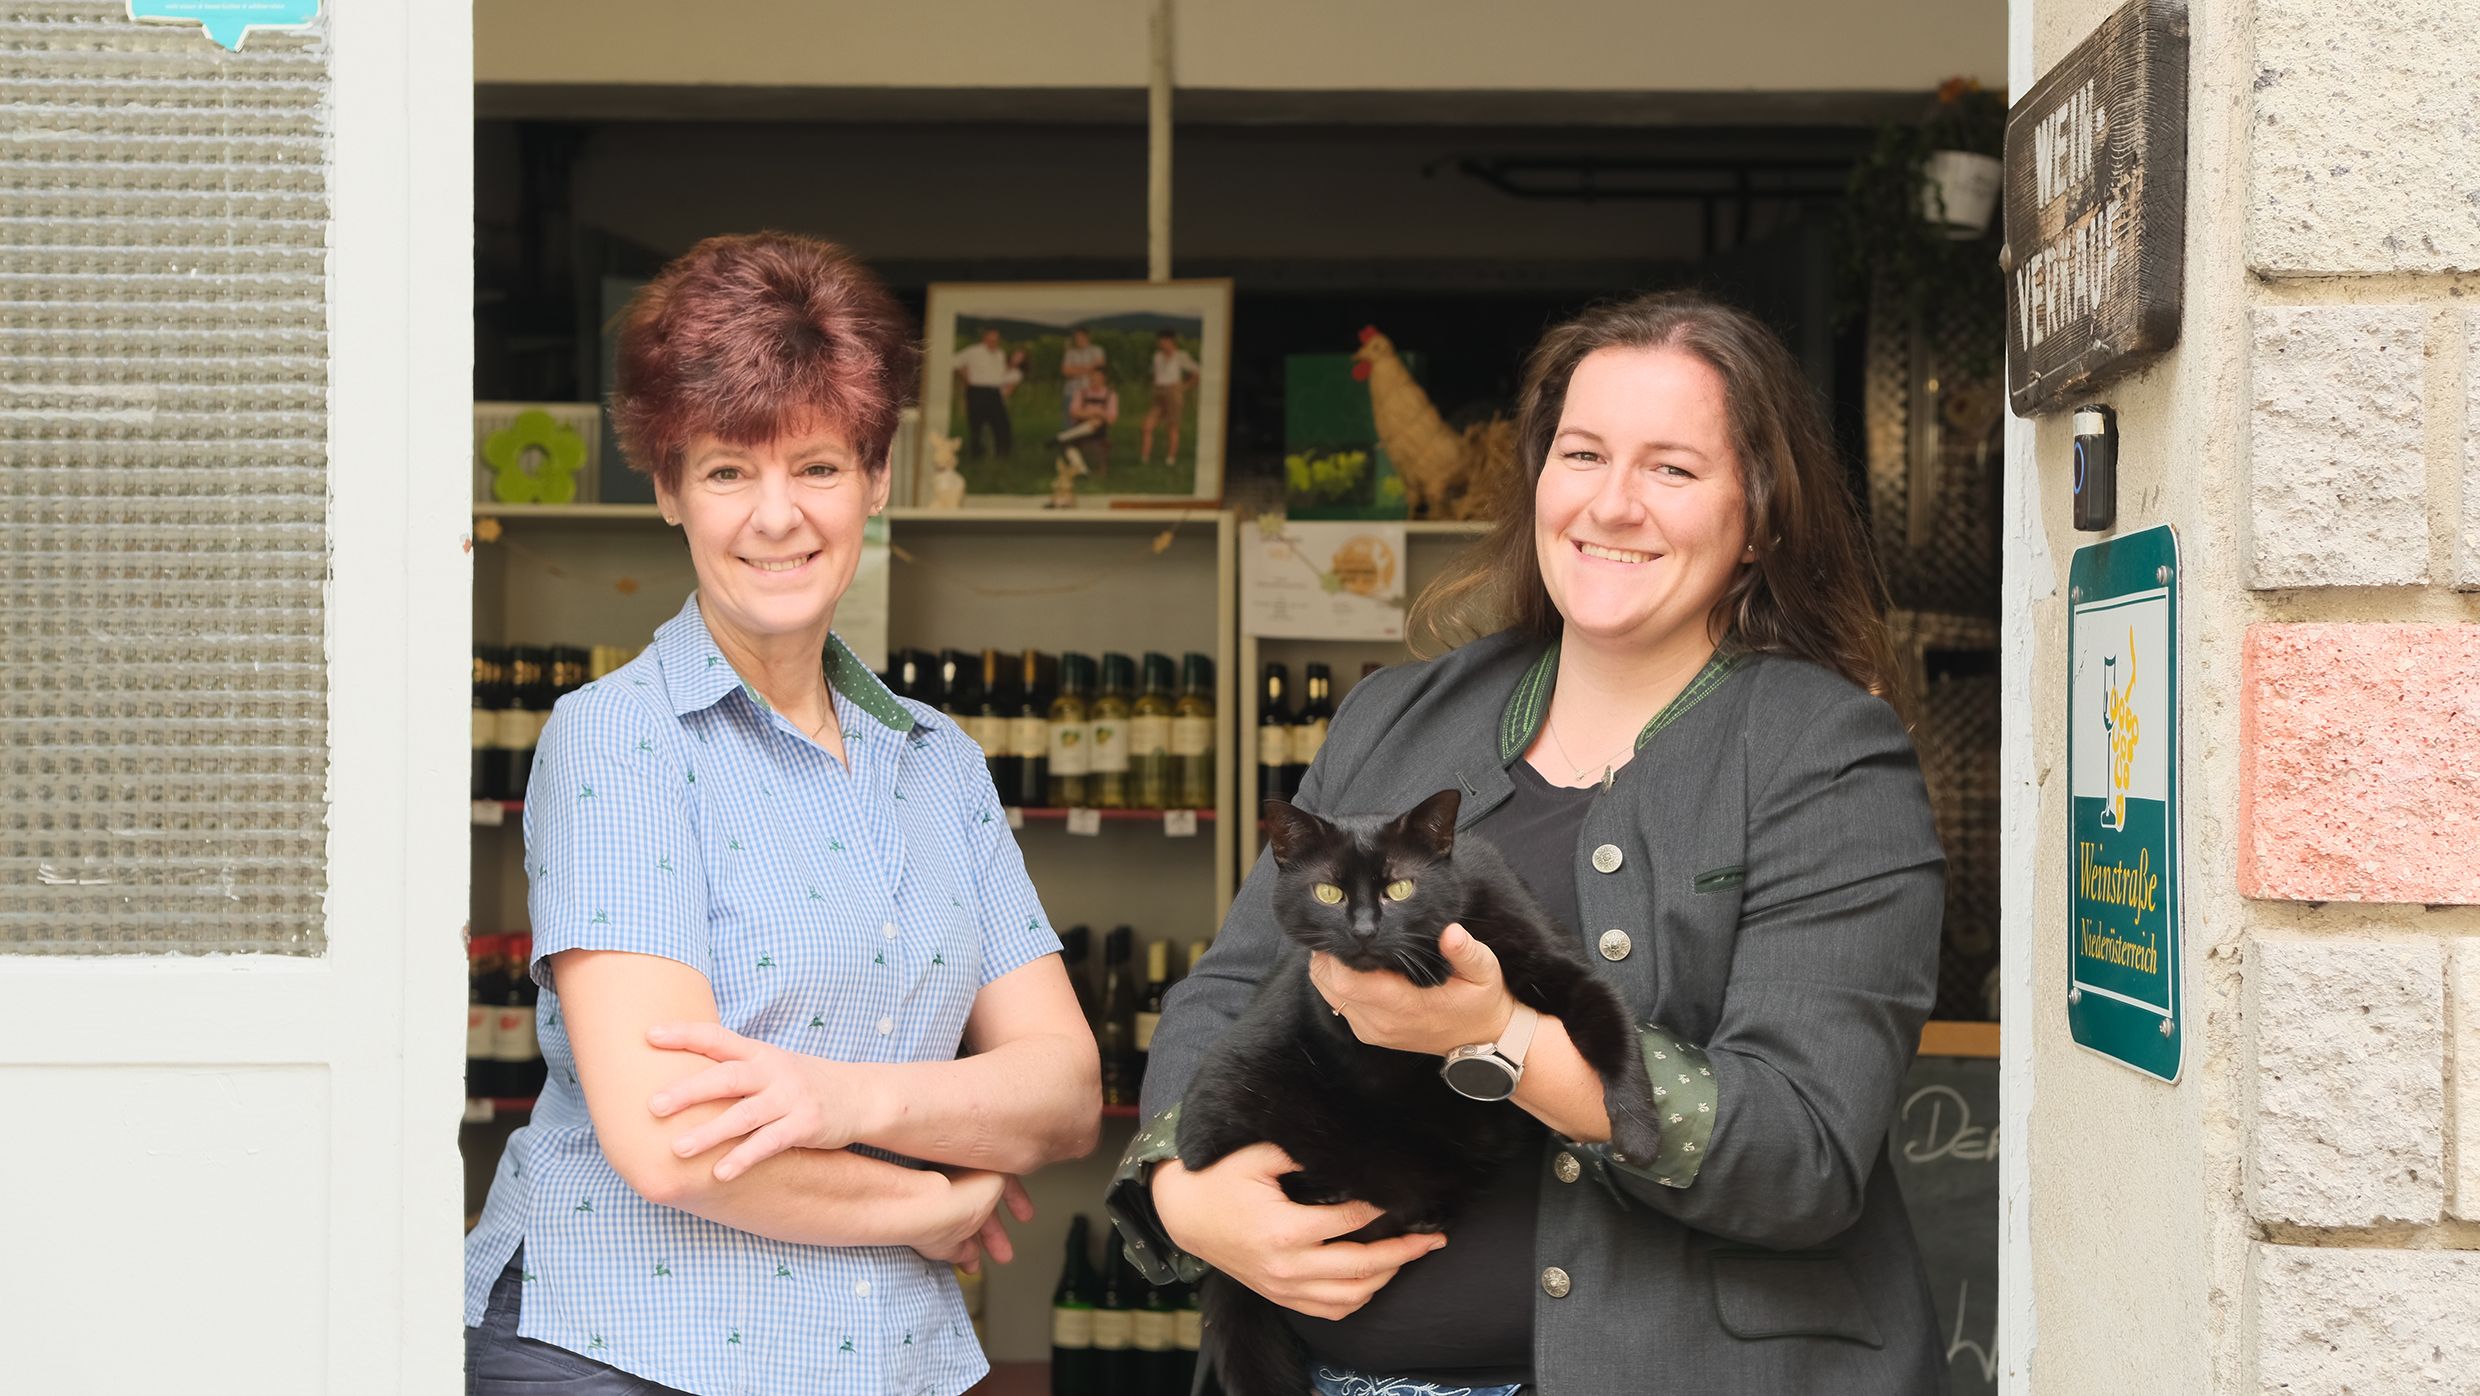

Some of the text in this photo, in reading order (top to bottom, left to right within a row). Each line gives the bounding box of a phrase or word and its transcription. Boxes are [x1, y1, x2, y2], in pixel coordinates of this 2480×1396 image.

[2035, 79, 2105, 208] WEIN-
[2080, 842, 2157, 925] Weinstraße
[2081, 918, 2157, 975] Niederösterreich
